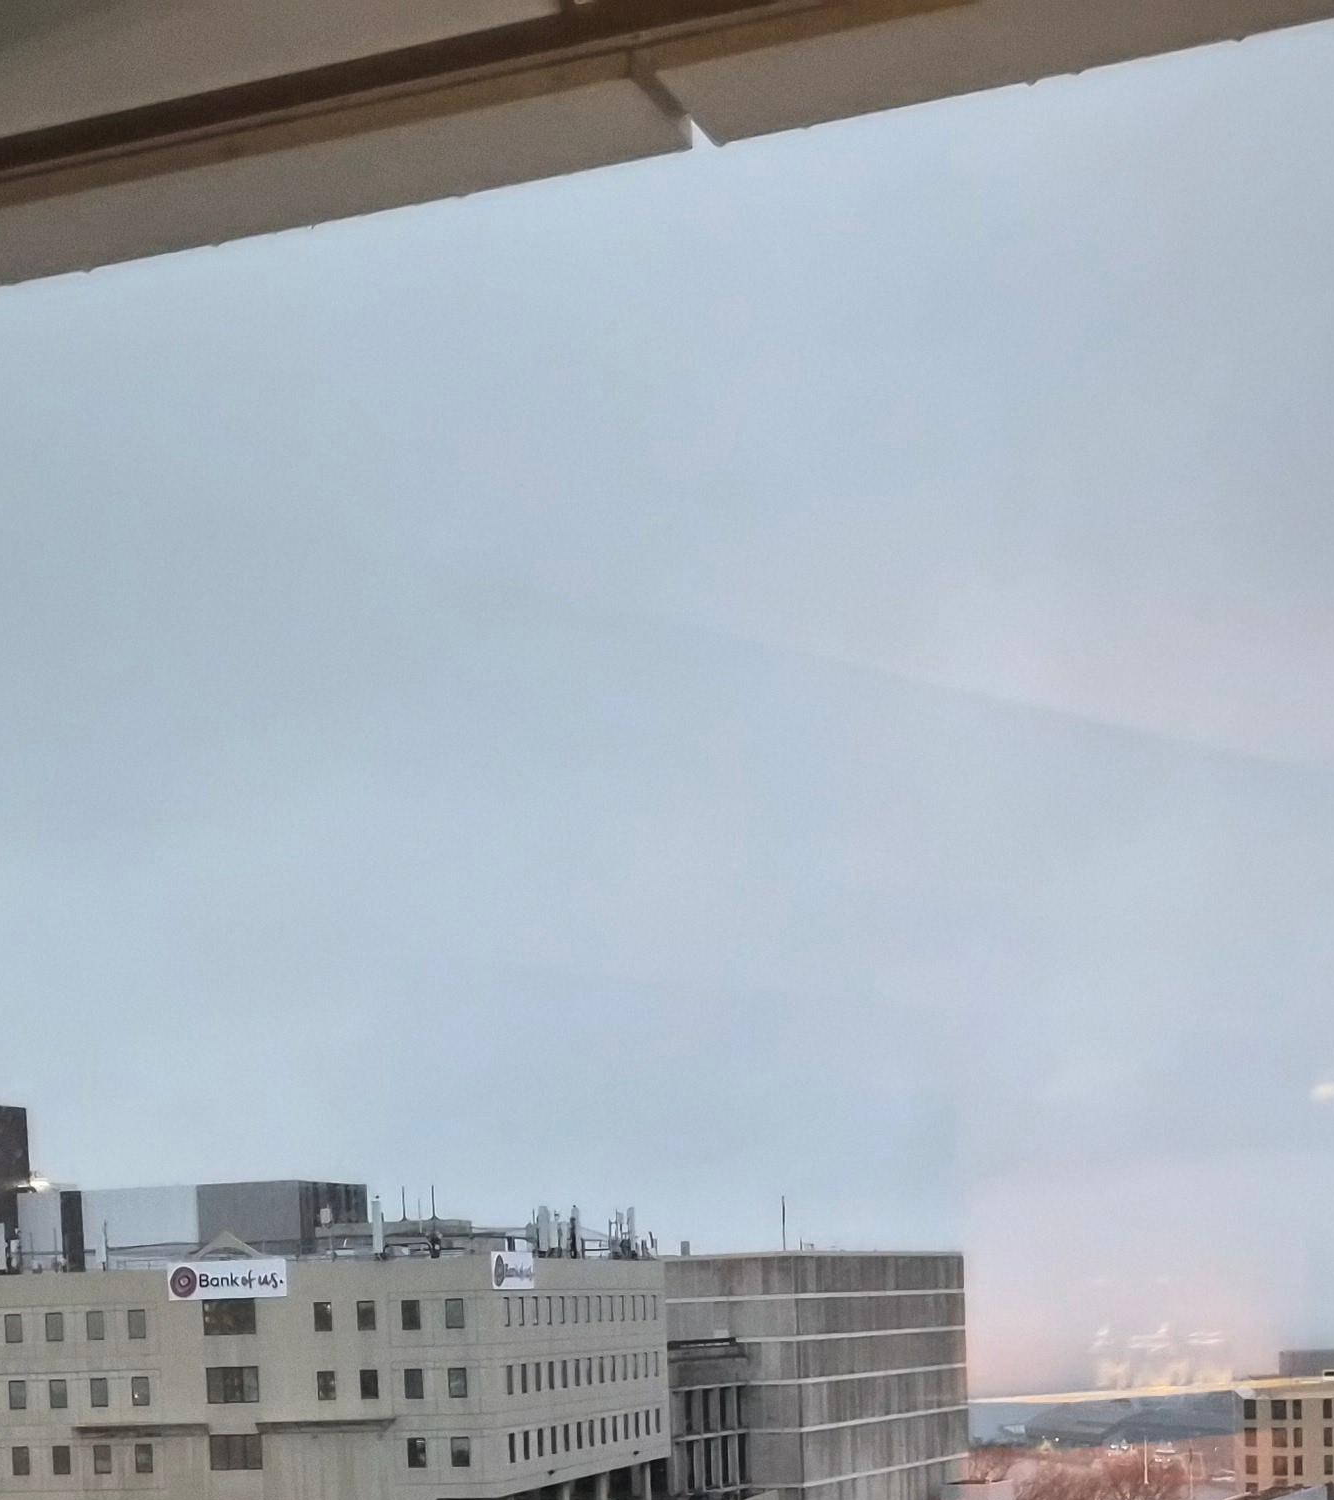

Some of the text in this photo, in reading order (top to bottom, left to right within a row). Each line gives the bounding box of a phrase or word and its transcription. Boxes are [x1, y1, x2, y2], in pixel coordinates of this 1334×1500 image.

[198, 1269, 284, 1289] Bank of us.
